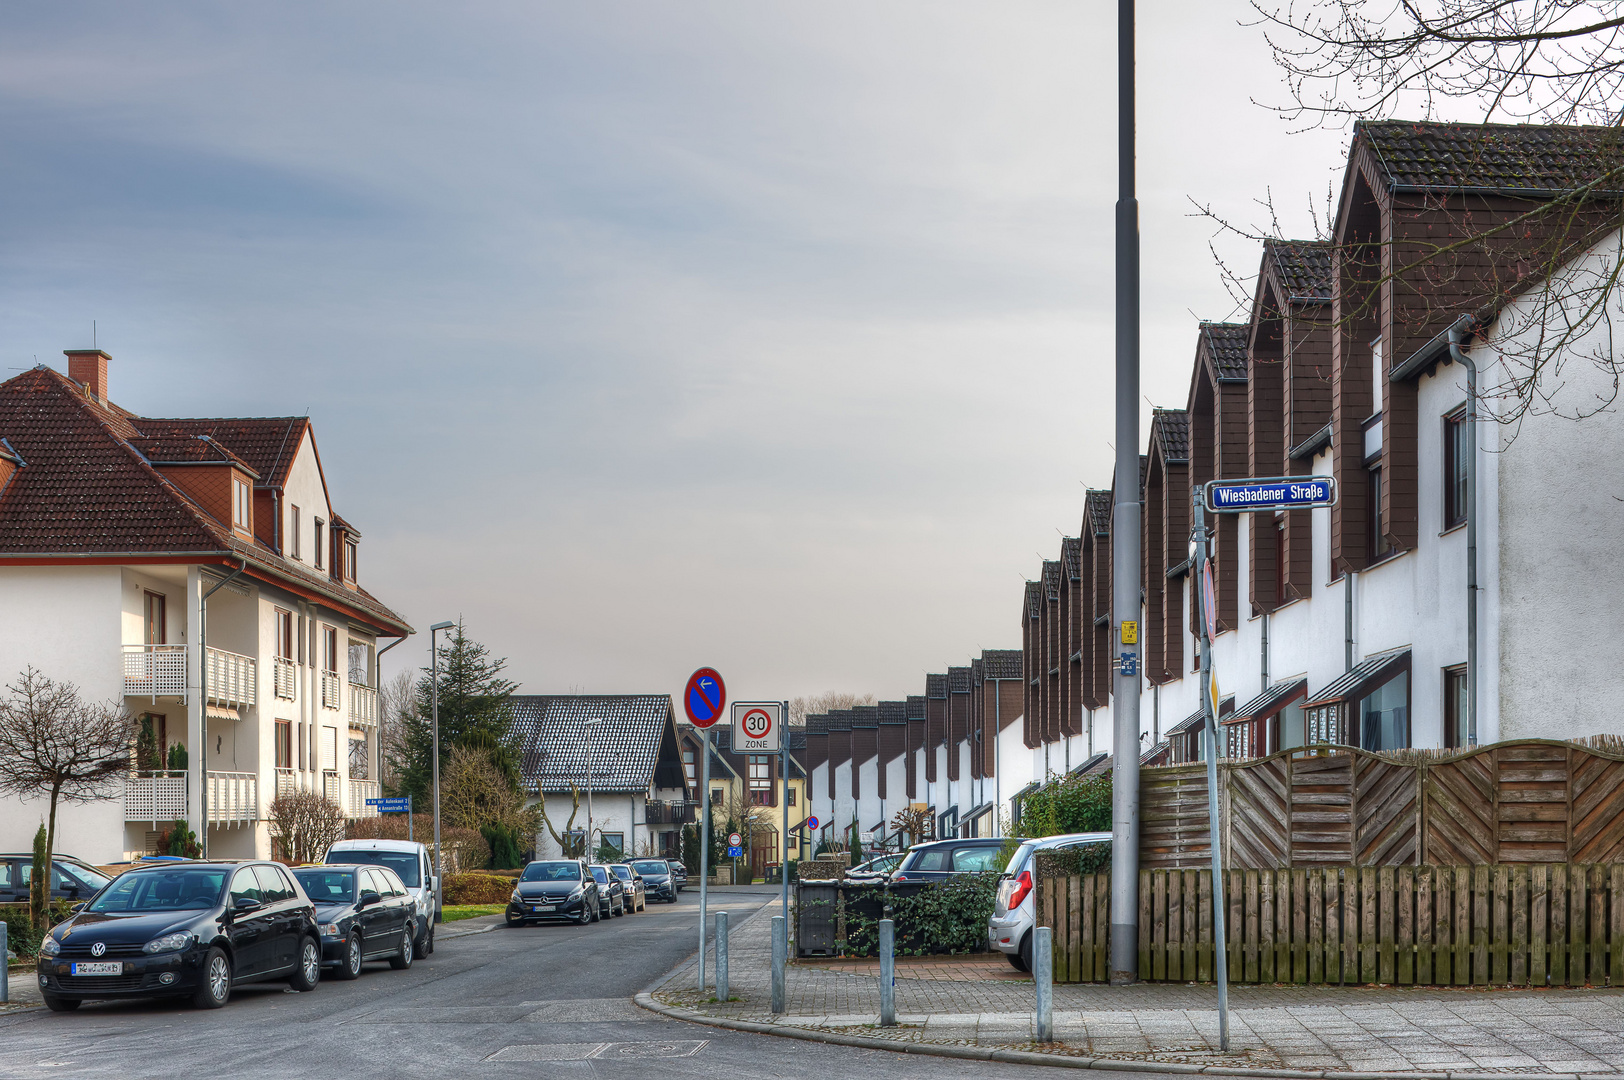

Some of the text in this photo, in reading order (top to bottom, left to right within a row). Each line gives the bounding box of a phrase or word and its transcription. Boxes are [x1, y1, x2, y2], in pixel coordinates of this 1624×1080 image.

[1219, 484, 1323, 503] Wiesbadener Straße
[748, 717, 765, 730] 30
[91, 942, 106, 957] VW
